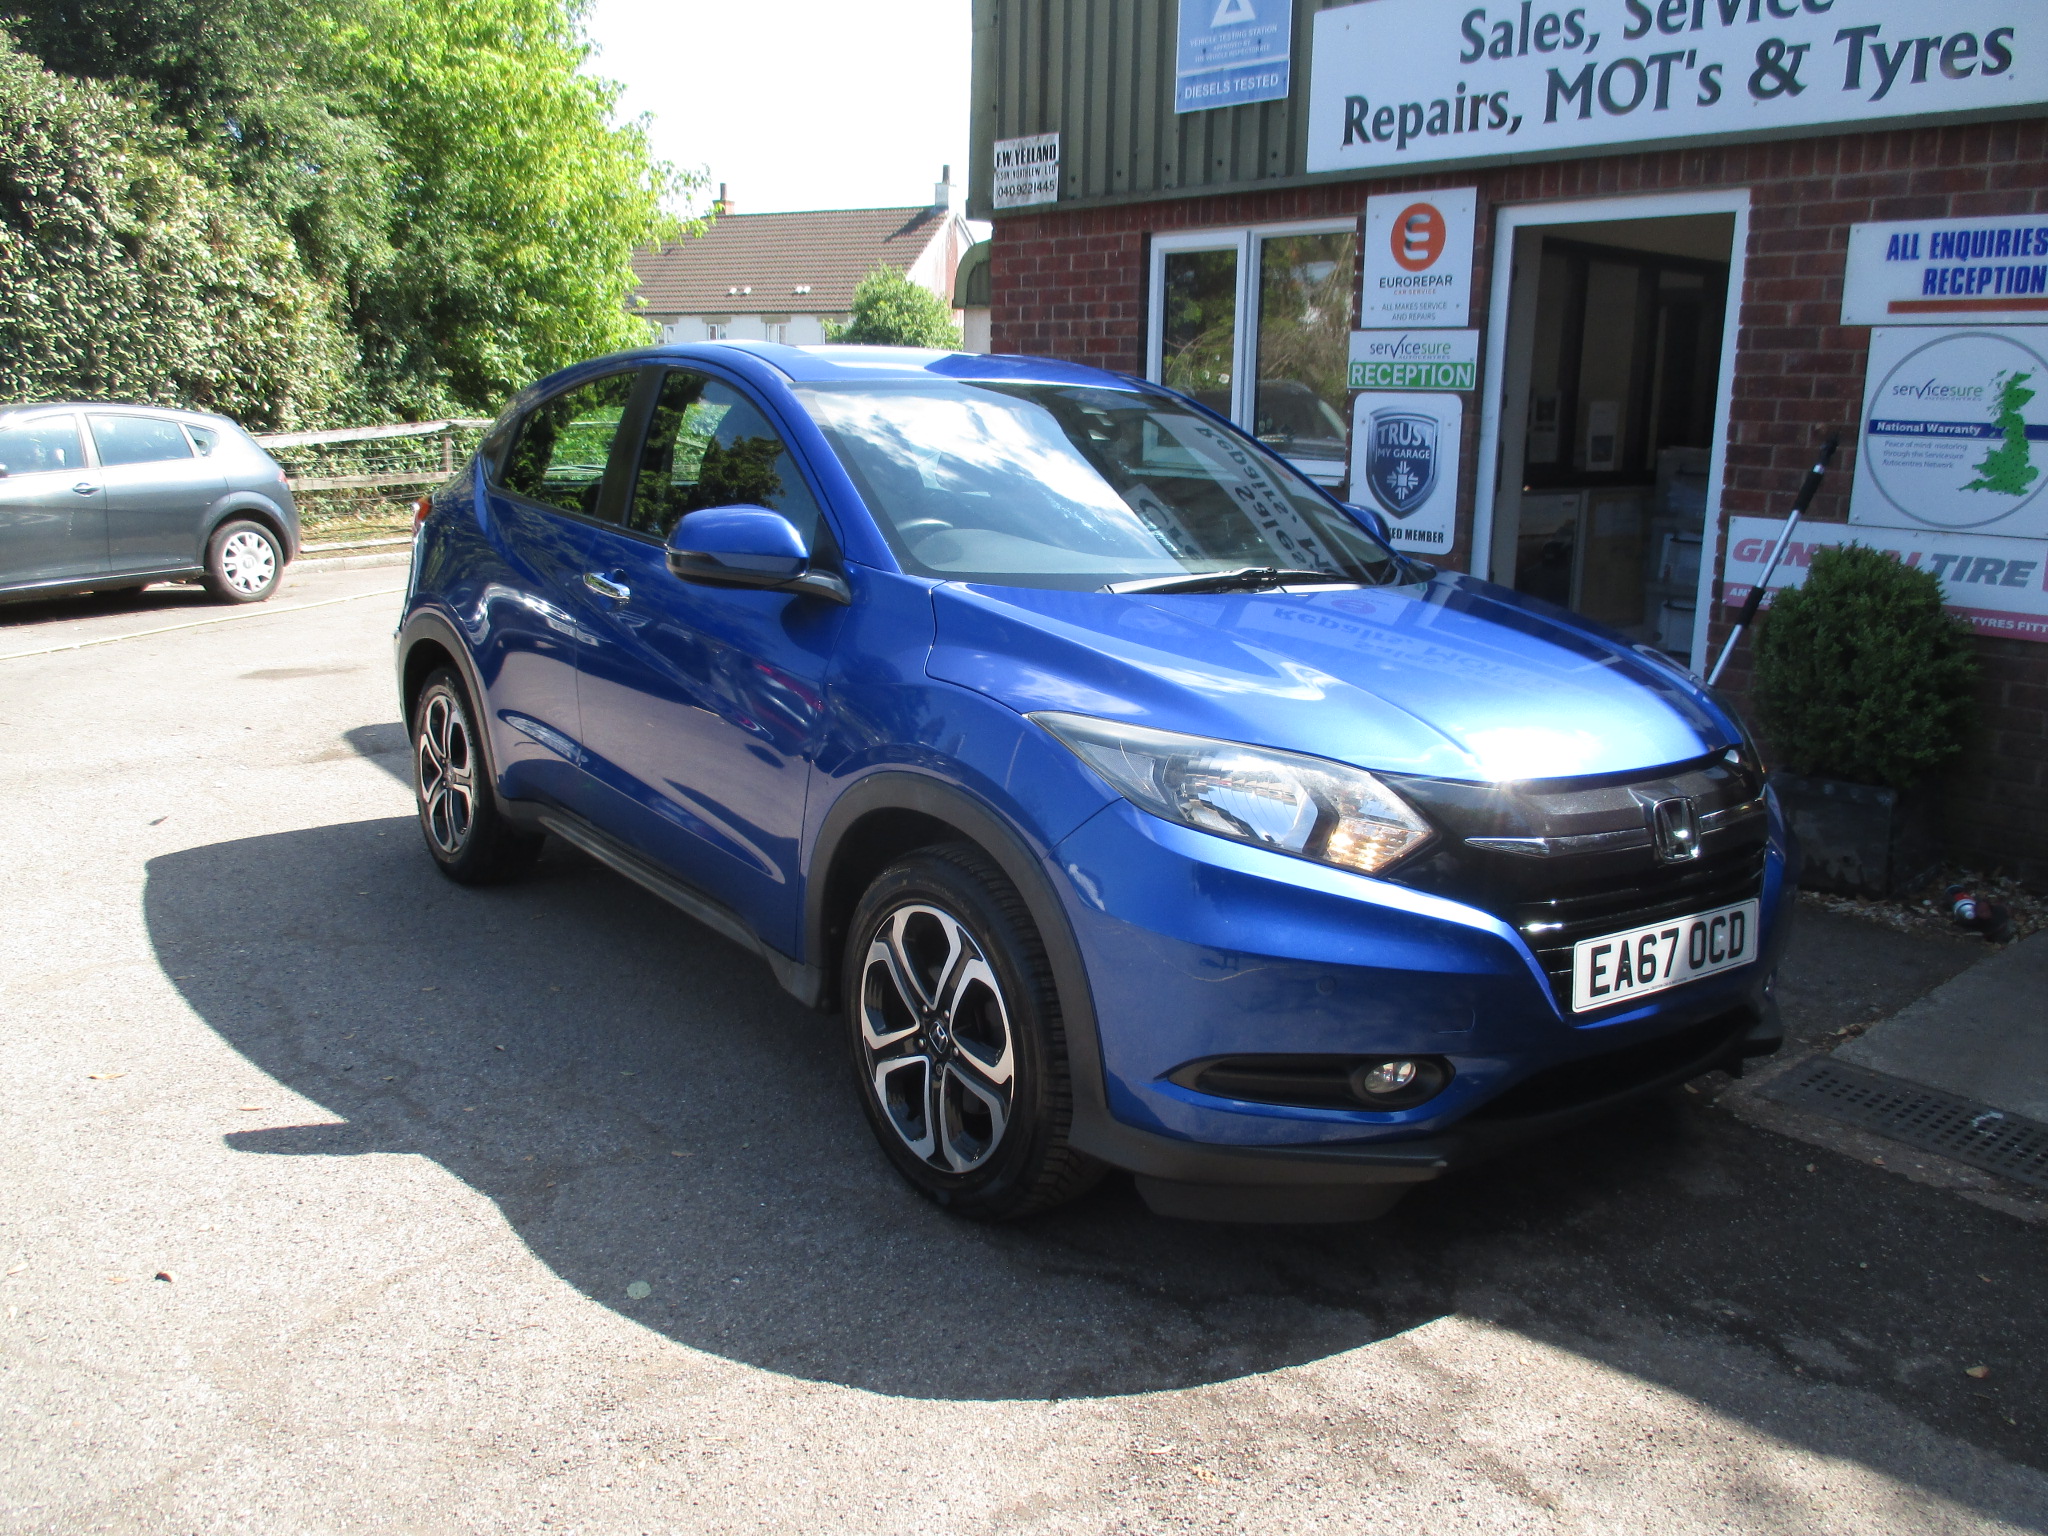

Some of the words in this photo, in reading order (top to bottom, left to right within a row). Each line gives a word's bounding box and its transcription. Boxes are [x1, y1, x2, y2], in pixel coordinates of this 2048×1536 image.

[1248, 24, 1278, 37] STATION
[1459, 0, 1600, 64] Sales,
[1184, 80, 1231, 99] DIESELS
[1233, 73, 1279, 92] TESTED
[1342, 81, 1524, 151] Repairs,
[1543, 49, 1723, 124] MOT's
[1747, 38, 1811, 101] &
[1833, 24, 2014, 102] Tyres
[1886, 233, 1920, 261] ALL
[1929, 227, 2048, 262] ENQUIRIES
[1379, 274, 1453, 289] EUROREPAR
[1922, 265, 2048, 295] RECEPTION
[1381, 303, 1394, 311] ALL
[1394, 302, 1419, 311] MAKES
[1419, 301, 1448, 310] SERVICE
[1391, 313, 1408, 321] AND
[1408, 312, 1437, 320] REPAIRS
[1370, 334, 1452, 359] servicesure
[1351, 364, 1472, 387] RECEPTION
[1377, 422, 1433, 447] TRUST
[1876, 421, 1924, 433] National
[1926, 423, 1982, 436] Warranty
[1378, 448, 1392, 457] MY
[1393, 448, 1431, 460] GARAGE
[1404, 529, 1444, 543] MEMBER
[1930, 553, 2038, 588] TIRE
[1970, 616, 2014, 629] TYRES
[1590, 927, 1680, 998] EA67
[1688, 910, 1745, 971] OCD
